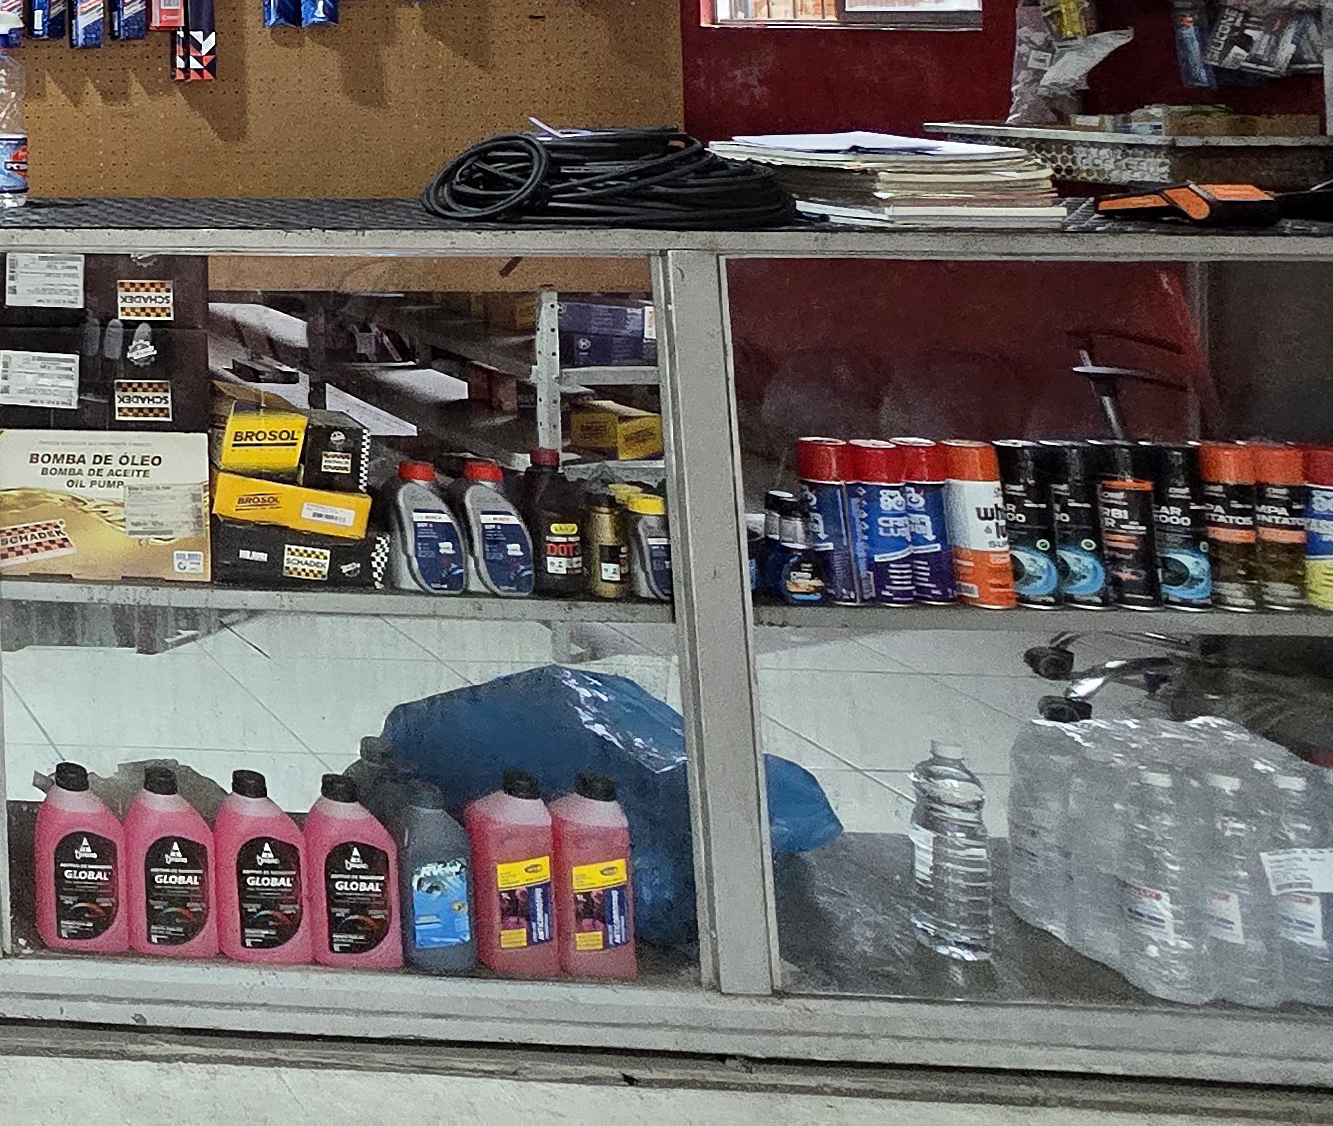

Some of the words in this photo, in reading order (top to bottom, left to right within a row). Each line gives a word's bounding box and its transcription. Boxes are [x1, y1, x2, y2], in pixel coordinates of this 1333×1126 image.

[120, 295, 171, 304] SCHADEK
[117, 395, 169, 404] SCHADEK
[233, 430, 299, 442] BROSOL
[29, 453, 86, 465] BOMBA
[92, 454, 113, 465] DE
[118, 452, 163, 467] ÓLEO
[41, 467, 83, 476] BOMBA
[87, 468, 103, 477] DE
[107, 469, 150, 478] ACEITE
[66, 479, 86, 489] OIL
[90, 480, 124, 489] PUMP
[237, 496, 281, 505] BROSOL
[0, 530, 66, 546] SCHADEK
[286, 558, 327, 569] SCHADEK
[64, 869, 109, 881] GLOBAL
[154, 874, 200, 886] GLOBAL
[246, 876, 292, 887] GLOBAL
[335, 880, 383, 892] GLOBAL
